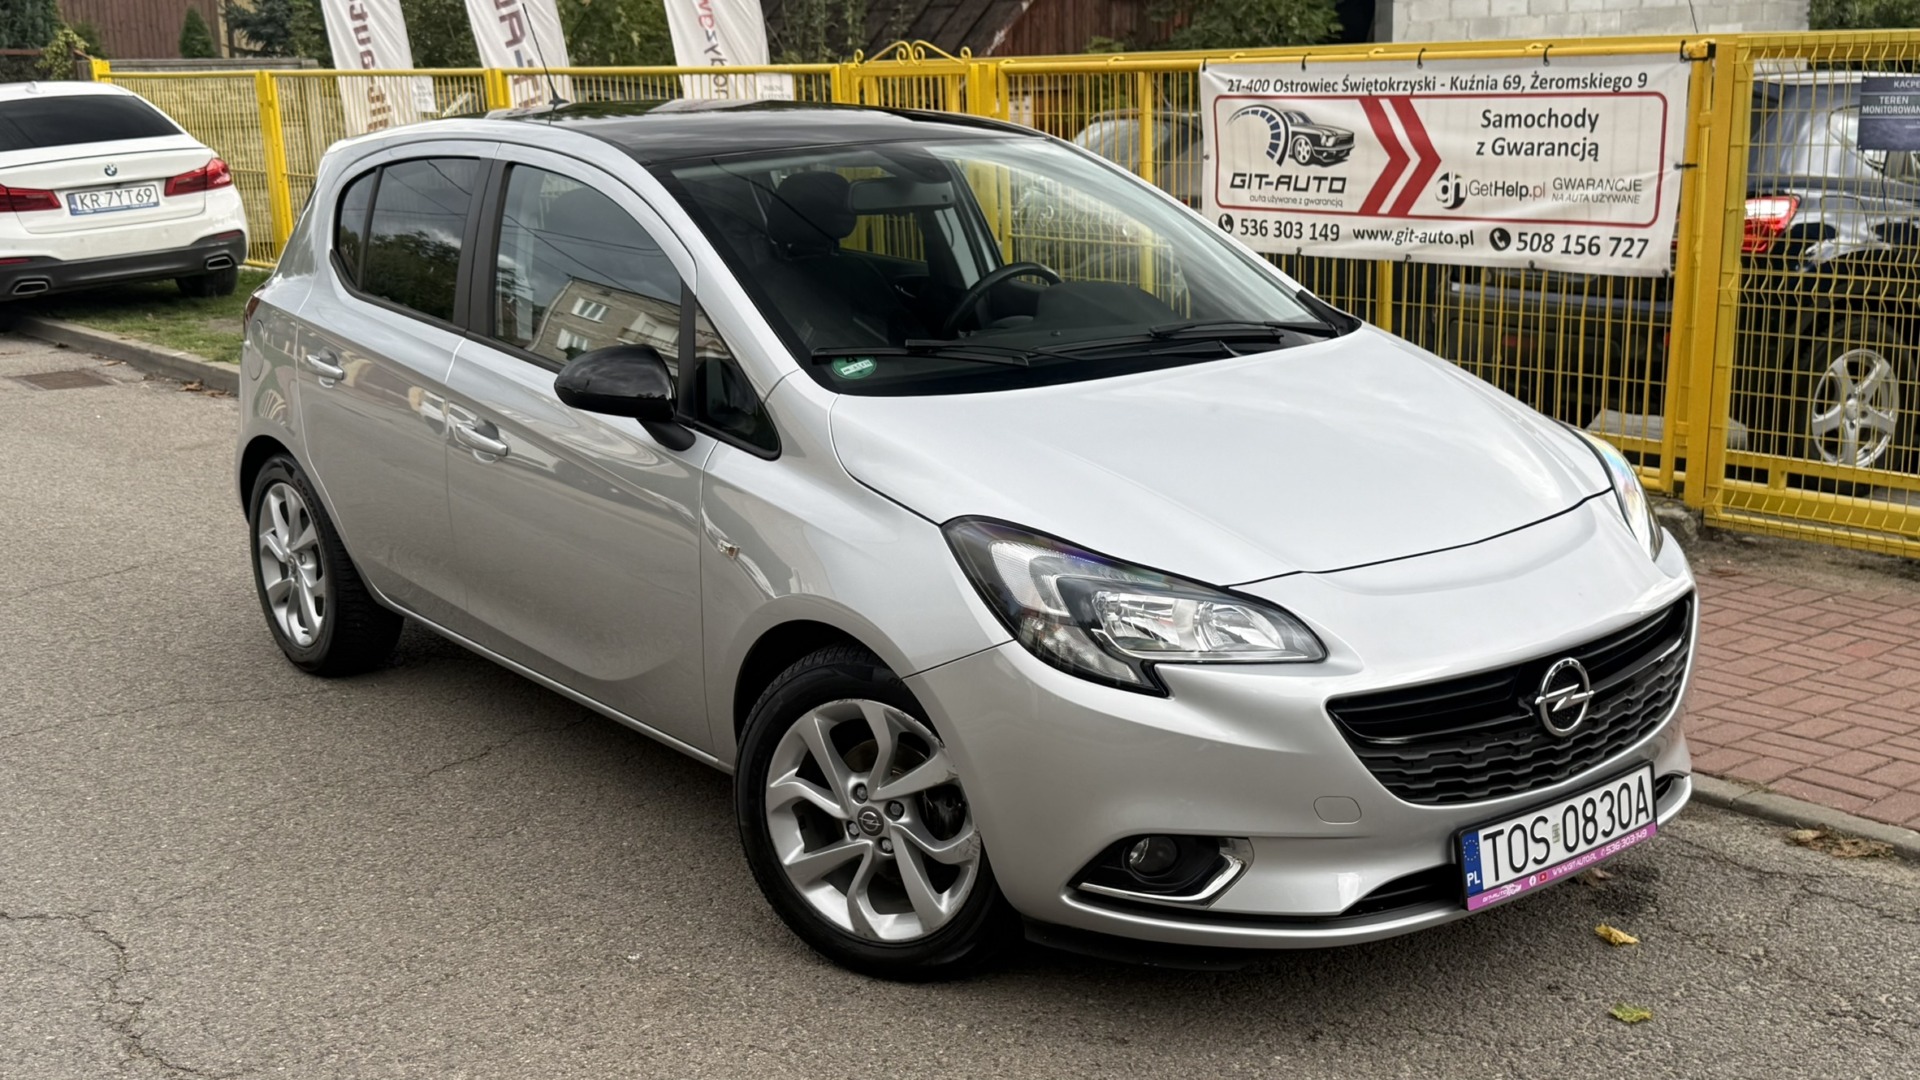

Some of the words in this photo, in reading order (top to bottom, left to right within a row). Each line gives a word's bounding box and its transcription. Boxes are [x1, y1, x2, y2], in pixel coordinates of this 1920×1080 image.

[1227, 79, 1270, 93] 27-400
[1273, 78, 1339, 93] Ostrowiec
[1342, 74, 1436, 96] Świętokrzyski
[1449, 74, 1498, 91] Kuźnia
[1502, 74, 1526, 93] 69,
[1530, 71, 1633, 92] Żeromskiego
[1637, 72, 1648, 88] 9
[1879, 96, 1909, 105] TEREN
[1480, 107, 1600, 133] Samochody
[1475, 140, 1486, 156] z
[1491, 136, 1599, 162] Gwarancją
[1229, 172, 1347, 194] GIT-AUTO
[1468, 179, 1546, 201] GetHelp.pl
[1552, 177, 1643, 192] GWARANCJE
[79, 193, 102, 210] KR
[105, 188, 153, 207] 7YT69
[1249, 194, 1267, 203] auta
[1267, 195, 1298, 205] używane
[1298, 197, 1303, 205] z
[1304, 198, 1343, 208] gwarancją
[1551, 193, 1564, 202] NA
[1565, 194, 1590, 203] AUTA
[1239, 218, 1269, 238] 536
[1273, 220, 1304, 240] 303
[1309, 222, 1341, 242] 149
[1352, 227, 1475, 248] www.git-auto.pl
[1516, 232, 1555, 253] 508
[1560, 234, 1602, 256] 156
[1609, 237, 1649, 259] 727
[1483, 815, 1551, 881] TOS
[1562, 775, 1650, 853] 0830A
[1467, 872, 1481, 888] PL
